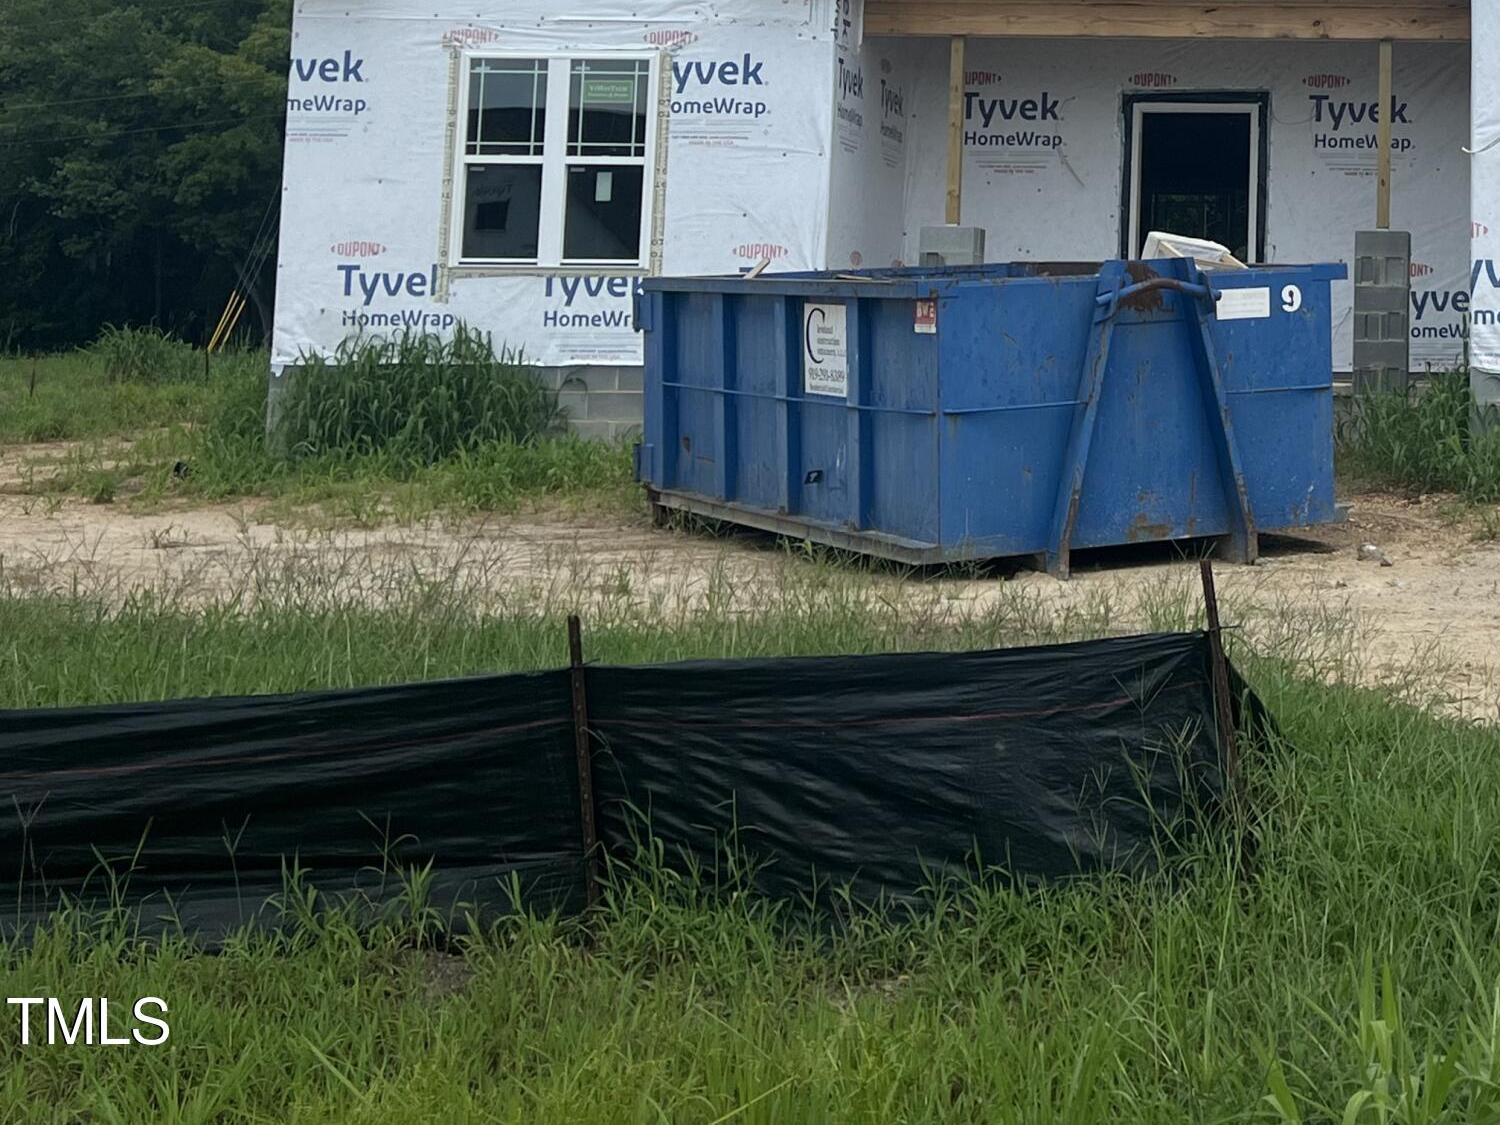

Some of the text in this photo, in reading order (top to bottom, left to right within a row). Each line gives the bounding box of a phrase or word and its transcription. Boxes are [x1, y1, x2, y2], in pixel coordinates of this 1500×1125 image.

[290, 50, 364, 82] vek
[672, 53, 763, 94] yvek
[838, 57, 863, 100] Tyvek
[964, 71, 997, 85] UPONT
[1134, 73, 1174, 88] DUPONT
[1308, 74, 1345, 88] DUPONT
[286, 95, 366, 115] meWrap
[671, 97, 766, 118] omeWrap
[964, 92, 1059, 128] Tyvek
[964, 130, 1063, 149] HomeWrap
[1314, 133, 1412, 152] HomeWap
[337, 241, 380, 257] DUPONT
[739, 244, 783, 259] DUPONT
[1410, 262, 1428, 277] ONT
[1281, 284, 1302, 312] 9
[1411, 290, 1470, 320] yve
[342, 309, 454, 330] HomeWrap
[543, 310, 631, 327] HomeWr
[1411, 323, 1466, 339] omeW
